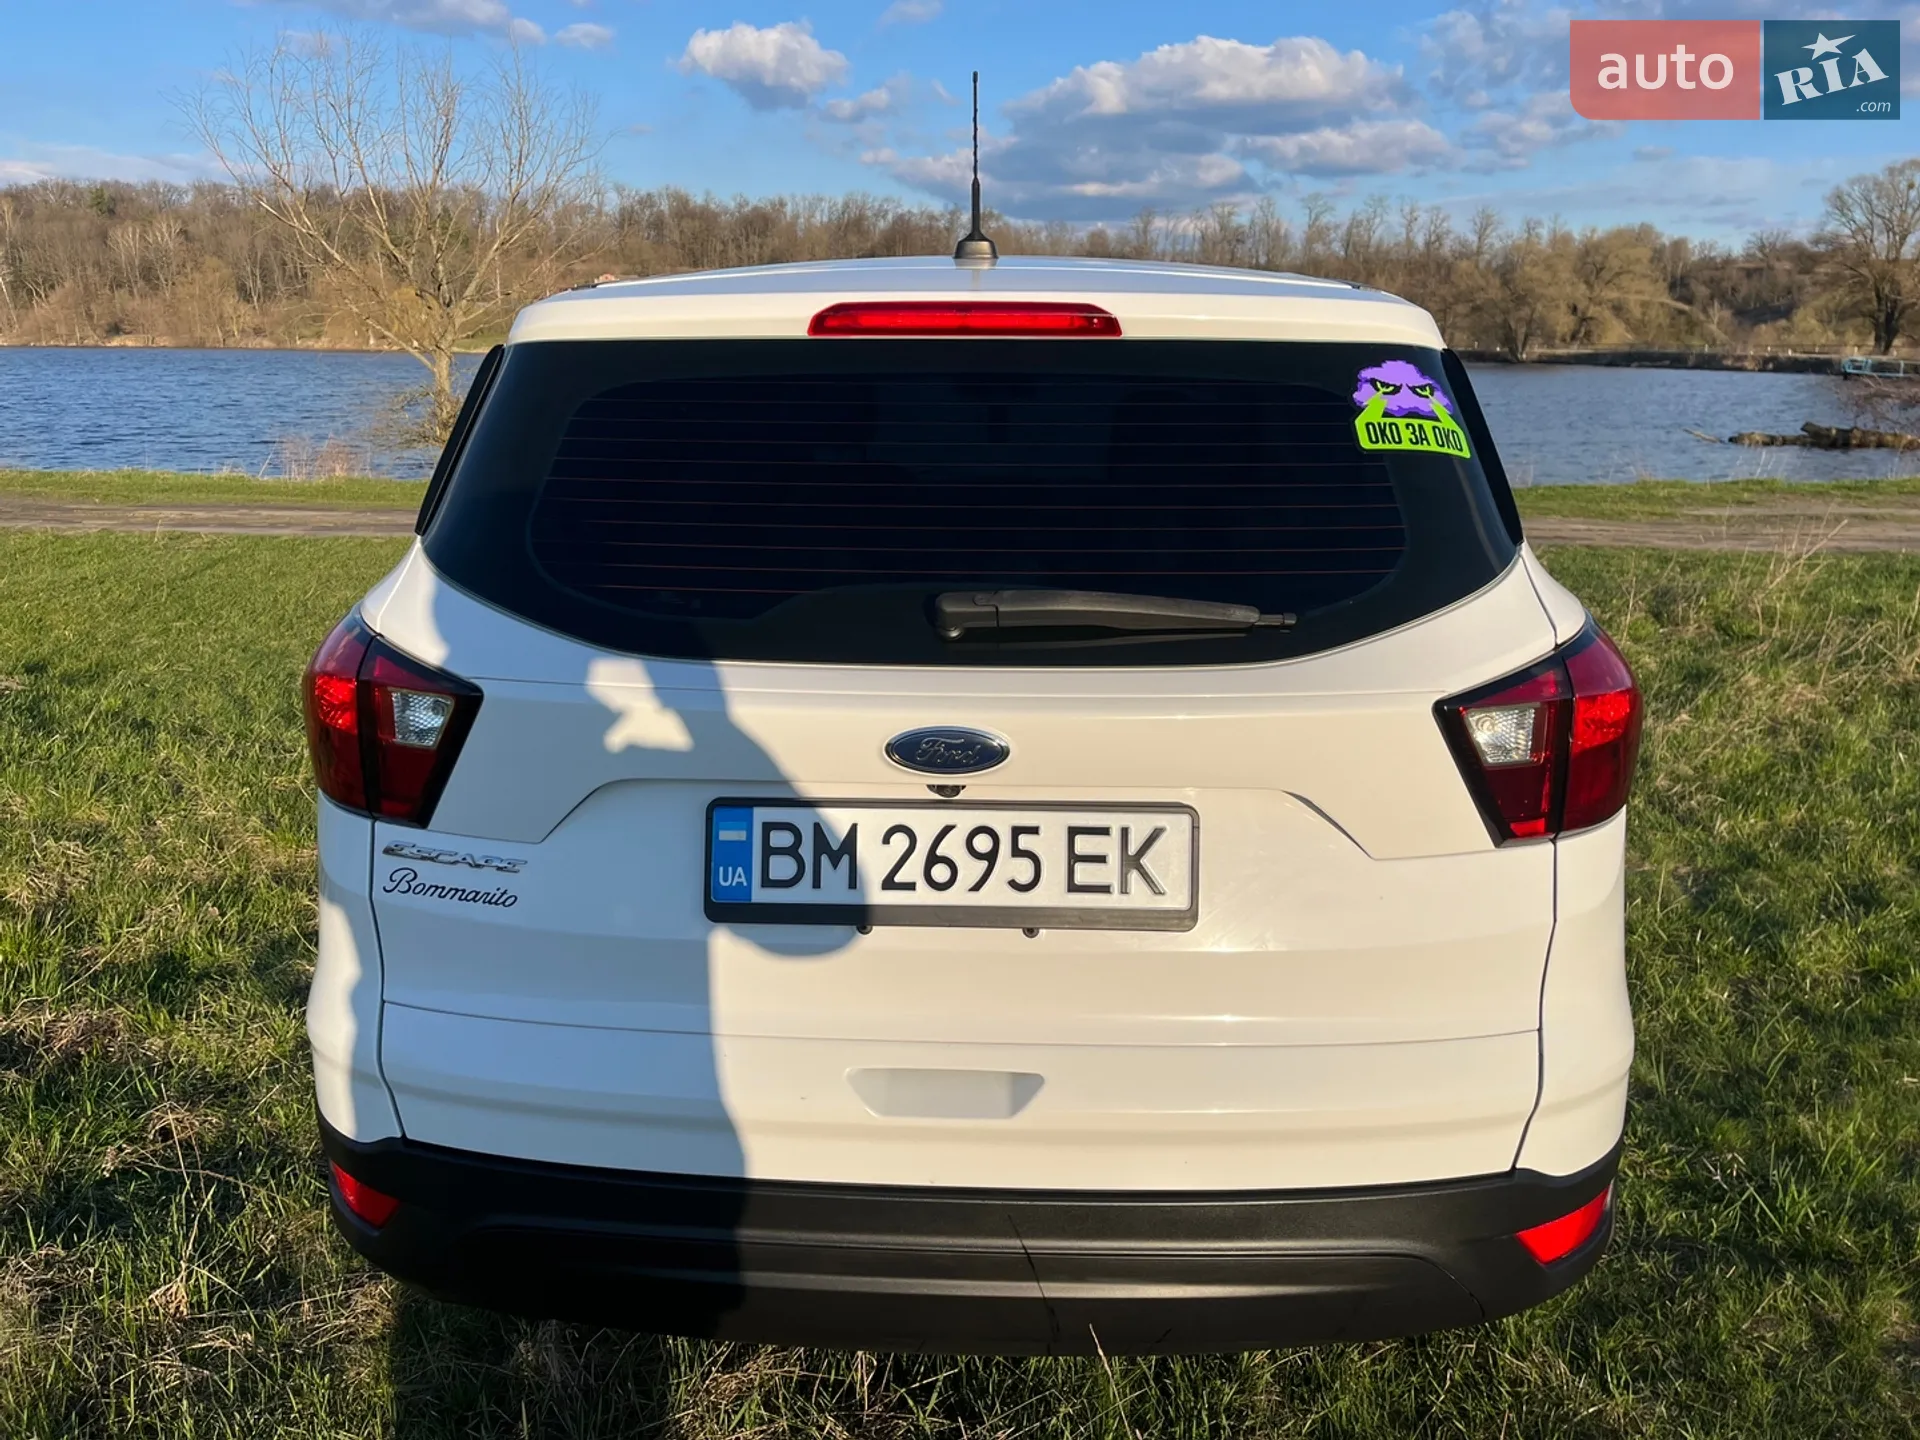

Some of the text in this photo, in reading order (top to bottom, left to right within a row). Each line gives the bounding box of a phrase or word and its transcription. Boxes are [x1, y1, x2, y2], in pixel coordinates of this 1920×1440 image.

[1365, 422, 1403, 445] ОКО
[915, 736, 981, 763] Ford
[760, 821, 1167, 896] BM 2695 EK
[382, 866, 519, 909] Bommarito
[717, 865, 748, 888] UA
